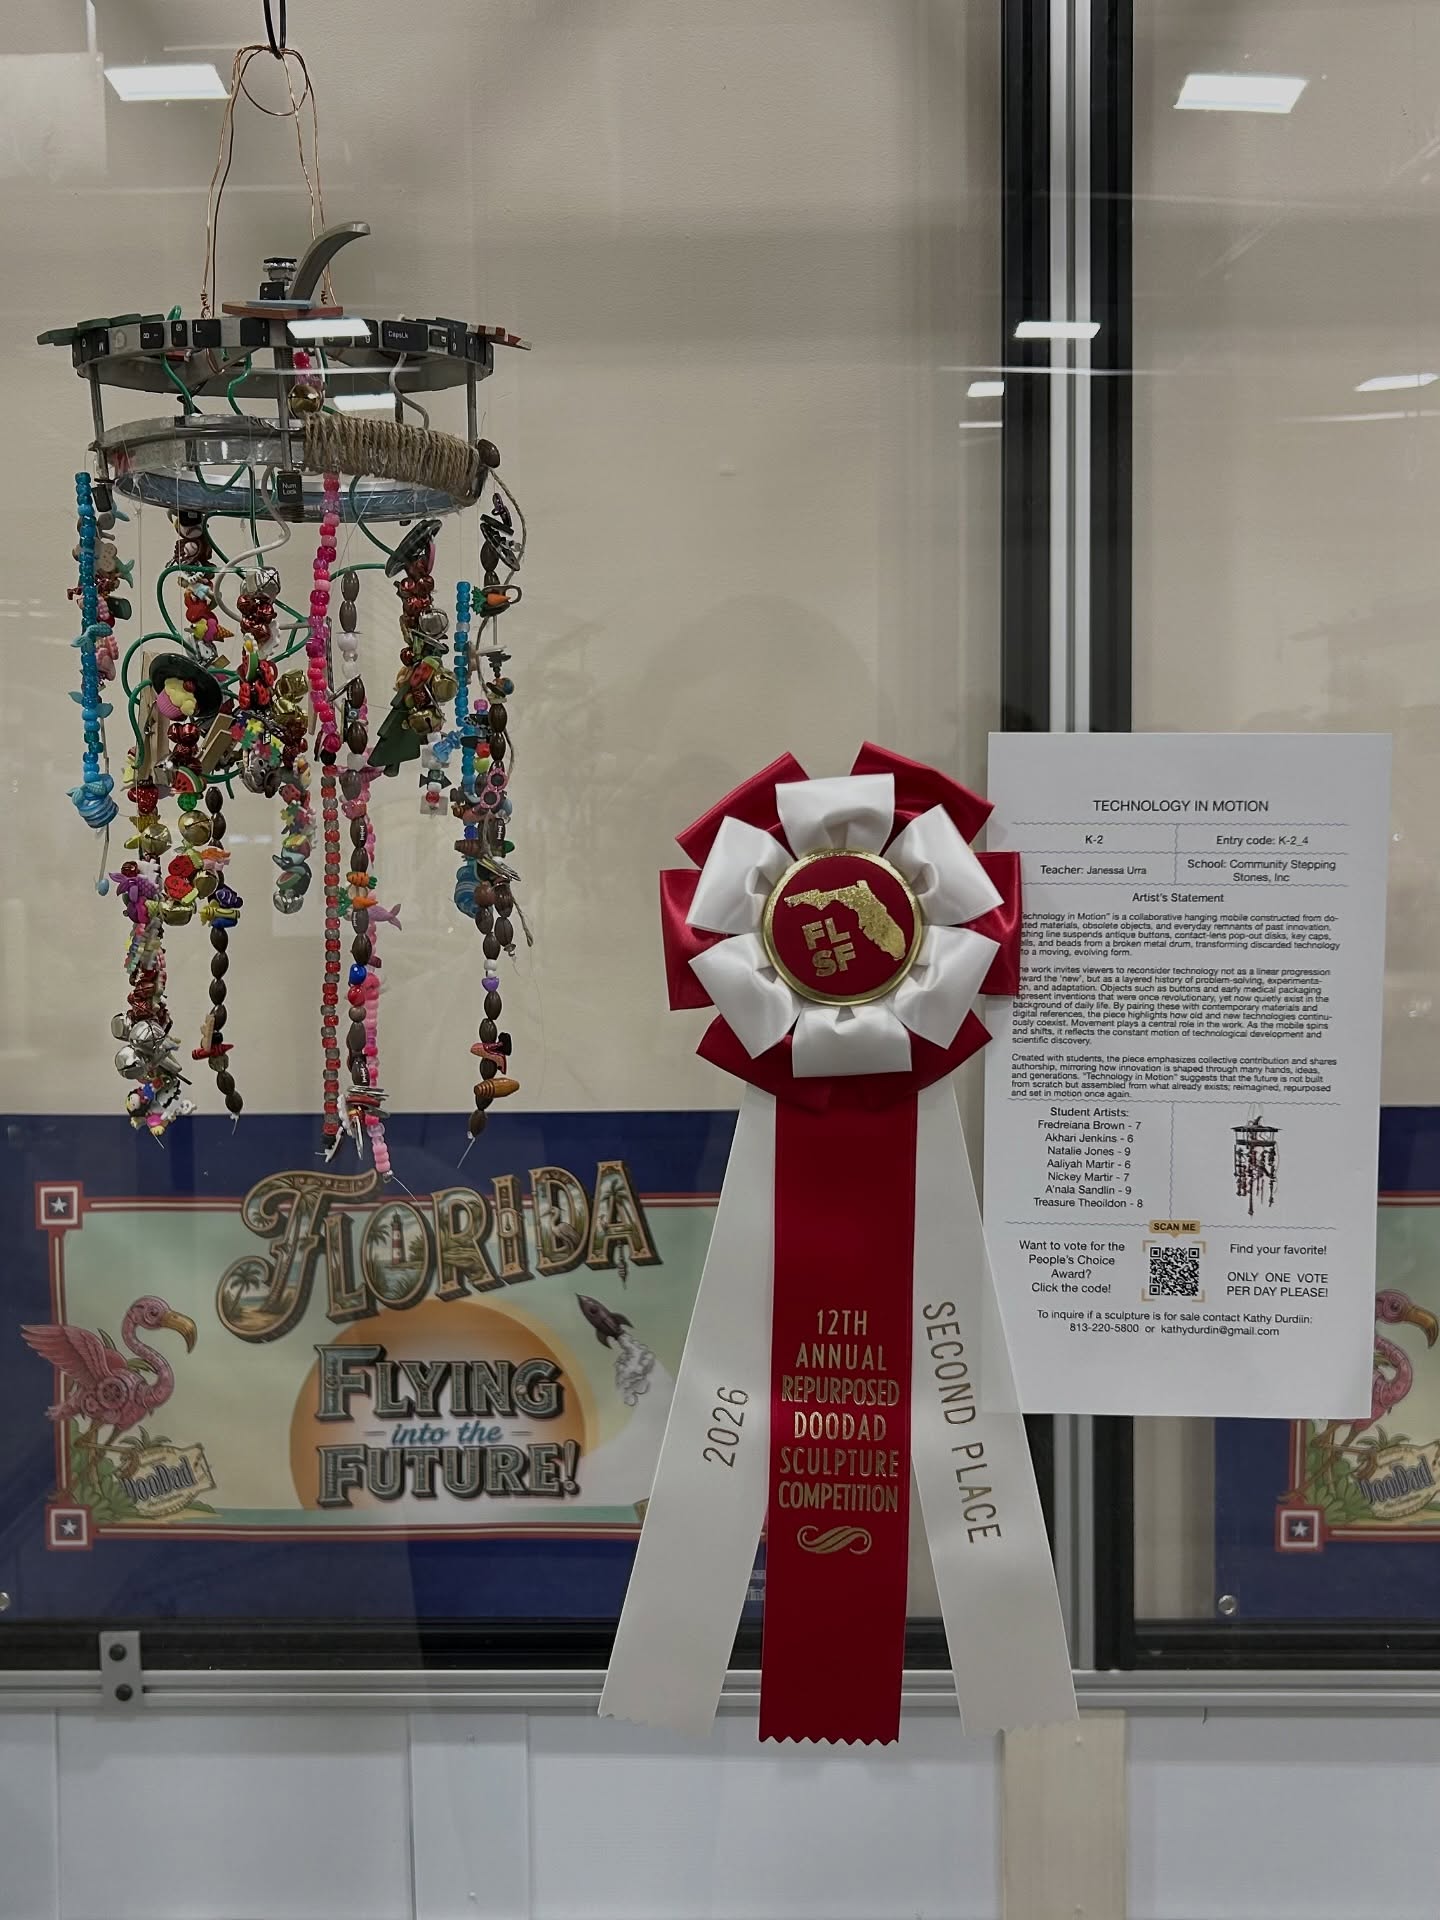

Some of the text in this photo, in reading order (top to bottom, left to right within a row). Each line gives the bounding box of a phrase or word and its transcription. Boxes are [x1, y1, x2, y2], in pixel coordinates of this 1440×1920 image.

[1092, 800, 1269, 812] TECHNOLOGY IN MOTION
[1085, 835, 1103, 844] K-2
[1216, 835, 1308, 847] Entry code: K-2_4
[1039, 865, 1084, 874] Teacher:
[1086, 865, 1124, 875] Janessa
[1187, 860, 1336, 872] School: Community Stepping
[1232, 872, 1290, 882] Stones, Inc
[1132, 892, 1224, 902] Artist's Statement
[1021, 912, 1065, 921] echnology
[1184, 913, 1218, 922] hanging
[802, 918, 850, 950] FL
[812, 942, 856, 976] SF
[1029, 1027, 1055, 1035] shifts,
[1192, 1029, 1248, 1038] technological
[1249, 1029, 1304, 1038] development
[1050, 1036, 1092, 1045] discovery.
[1029, 1071, 1080, 1080] generations.
[1179, 1073, 1218, 1082] suggests
[1106, 1090, 1132, 1099] again.
[1050, 1107, 1130, 1117] Student Artists:
[1092, 1120, 1125, 1129] Brown
[1135, 1121, 1142, 1129] 7
[1078, 1134, 1117, 1143] Jenkins
[1126, 1134, 1133, 1143] 6
[1047, 1146, 1082, 1155] Natalie
[1084, 1147, 1114, 1156] Jones
[1124, 1147, 1130, 1156] 9
[1046, 1160, 1082, 1170] Aaliyah
[1085, 1160, 1115, 1169] Martir
[1124, 1160, 1131, 1169] 6
[1047, 1172, 1081, 1183] Nickey
[1084, 1173, 1113, 1181] Martir
[1123, 1173, 1130, 1182] 7
[1078, 1185, 1115, 1194] Sandlin
[1124, 1186, 1132, 1195] 9
[1034, 1198, 1075, 1207] Treasure
[1136, 1199, 1144, 1208] 8
[1154, 1222, 1196, 1232] SCAN ME
[1019, 1240, 1125, 1251] Want to vote for the
[1229, 1244, 1326, 1256] Find your favorite!
[216, 1160, 663, 1343] FLORIDA
[1028, 1254, 1115, 1266] People's Choice
[1050, 1268, 1092, 1279] Award?
[1227, 1272, 1328, 1283] ONLY ONE VOTE
[1031, 1282, 1111, 1293] Click the code!
[1226, 1286, 1328, 1297] PER DAY PLEASE!
[816, 1309, 868, 1336] 12TH
[1037, 1310, 1049, 1320] To
[1051, 1310, 1084, 1322] inquire
[1086, 1311, 1094, 1320] if
[1104, 1311, 1150, 1323] sculpture
[1152, 1312, 1161, 1321] is
[1163, 1312, 1178, 1322] for
[1179, 1312, 1201, 1322] sale
[1202, 1313, 1240, 1322] contact
[1242, 1313, 1272, 1325] Kathy
[1069, 1323, 1139, 1333] 813-220-5800
[1160, 1324, 1279, 1337] kathydurdin@gmail.com
[796, 1342, 887, 1372] ANNUAL
[313, 1344, 565, 1421] FLYING
[781, 1375, 900, 1406] REPURPOSED
[702, 1386, 748, 1468] 2026
[794, 1411, 886, 1441] DOODAD
[922, 1301, 1002, 1544] SECOND PLACE
[391, 1421, 503, 1446] into the
[780, 1447, 899, 1477] SCULPTURE
[316, 1440, 581, 1508] FUTURE!
[778, 1481, 898, 1512] COMPETITION
